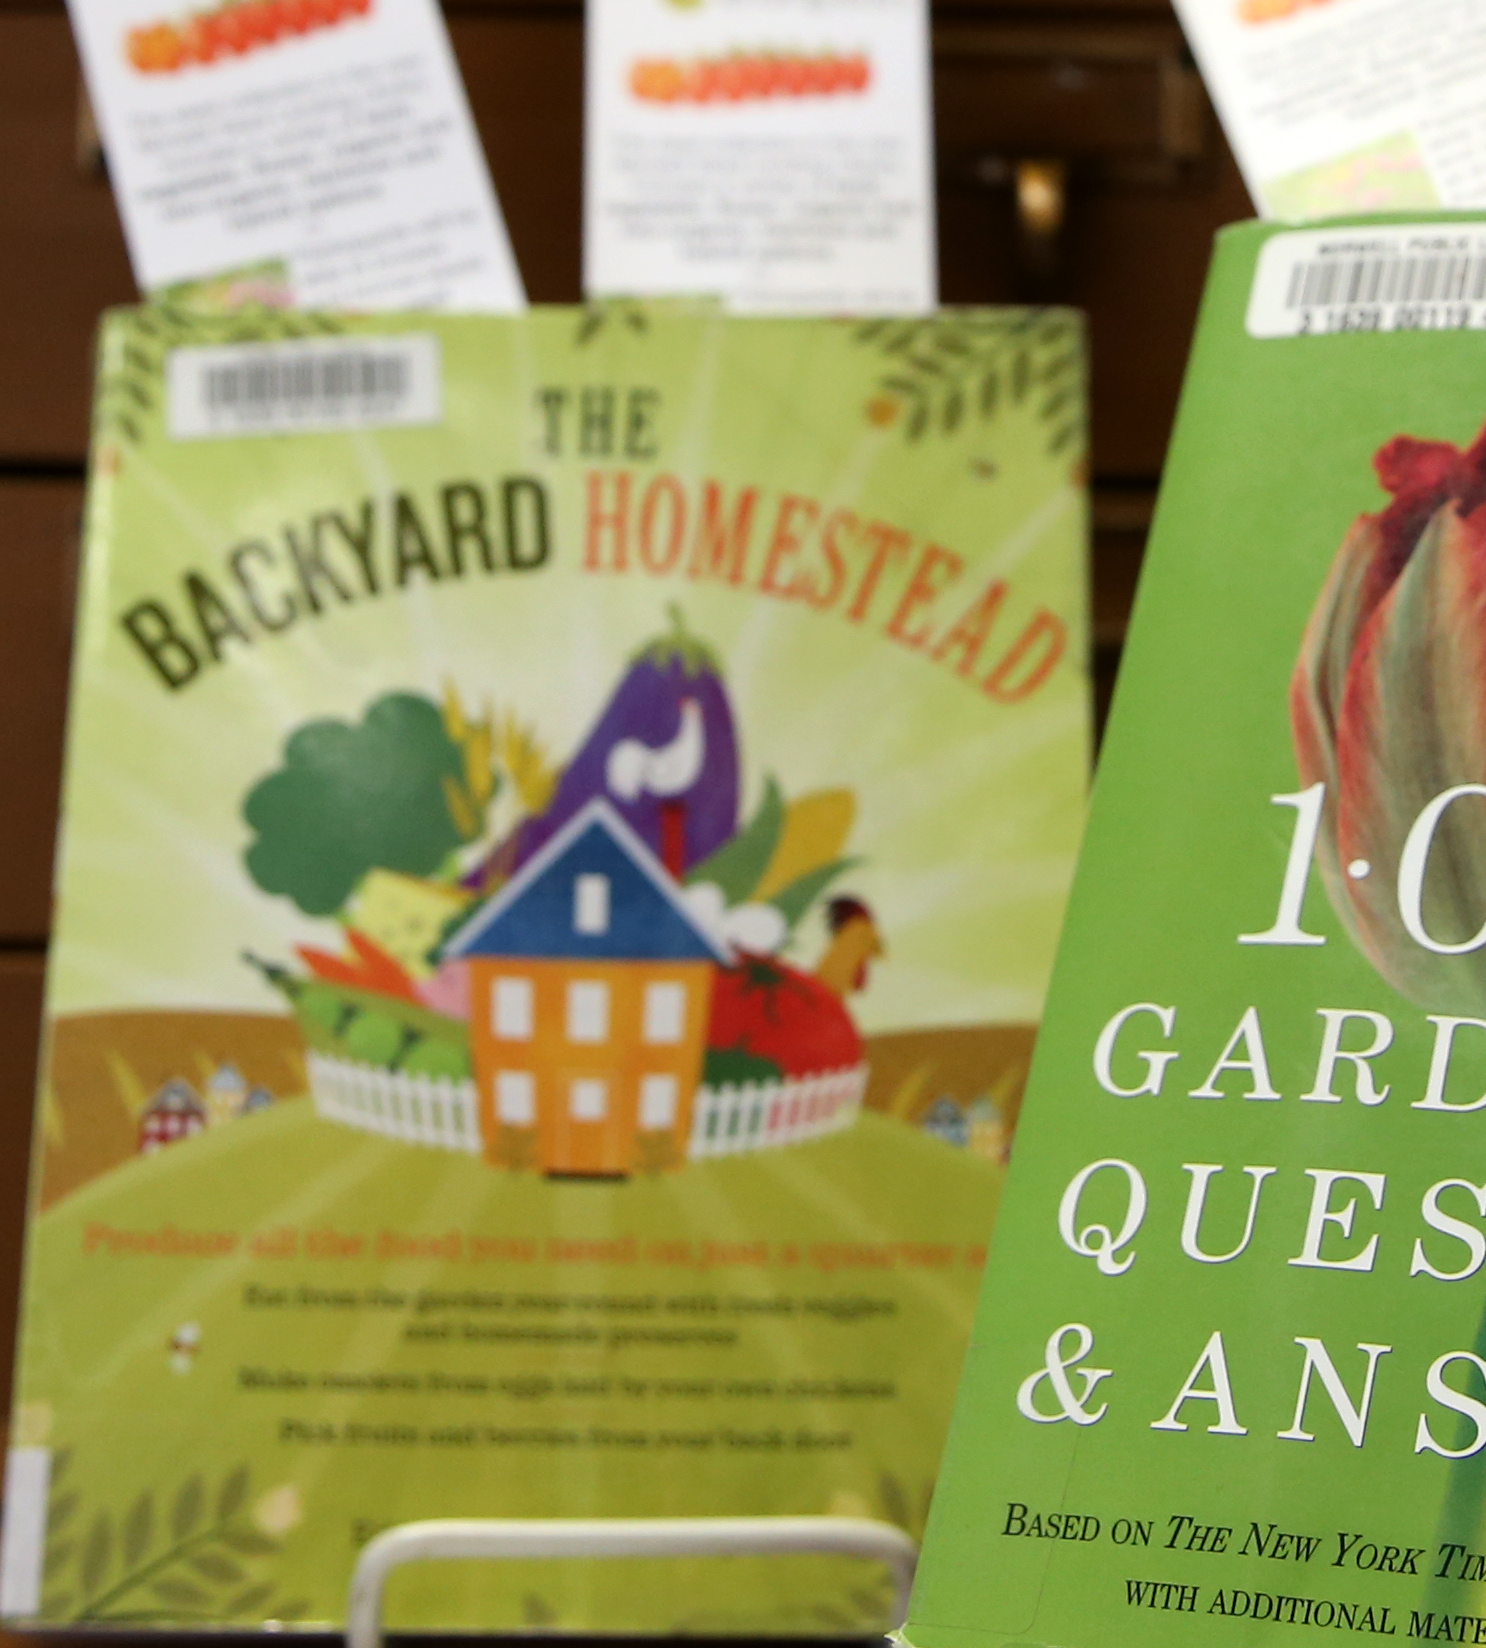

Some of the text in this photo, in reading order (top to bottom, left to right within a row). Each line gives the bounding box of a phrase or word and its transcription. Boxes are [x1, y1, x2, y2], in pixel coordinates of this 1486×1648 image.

[539, 388, 659, 459] THE
[121, 472, 1067, 704] BACKYARD HOMESTEAD
[1018, 1325, 1111, 1424] &
[1004, 1504, 1100, 1541] BASED
[1112, 1519, 1153, 1545] ON
[1166, 1516, 1232, 1552] THE
[1238, 1523, 1321, 1561] NEW
[1334, 1533, 1425, 1574] YORK
[1127, 1581, 1199, 1611] WITH
[1208, 1590, 1395, 1634] ADDITIONAL
